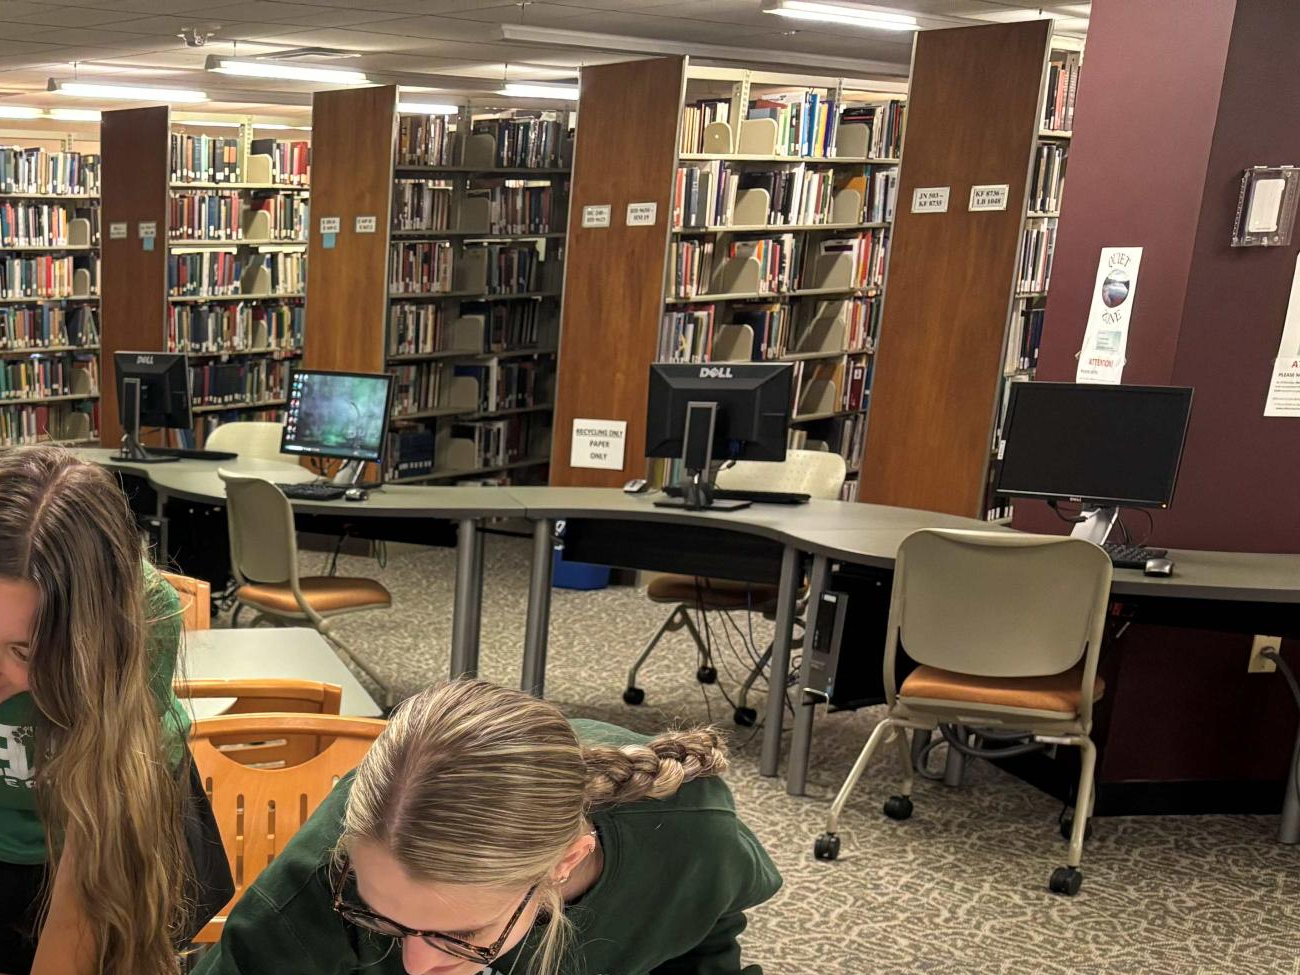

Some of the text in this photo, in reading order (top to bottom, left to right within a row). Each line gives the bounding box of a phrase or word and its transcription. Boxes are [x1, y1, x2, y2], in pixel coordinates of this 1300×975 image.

[700, 367, 733, 379] DELL
[589, 439, 610, 448] PAPER
[590, 451, 608, 461] ONLY
